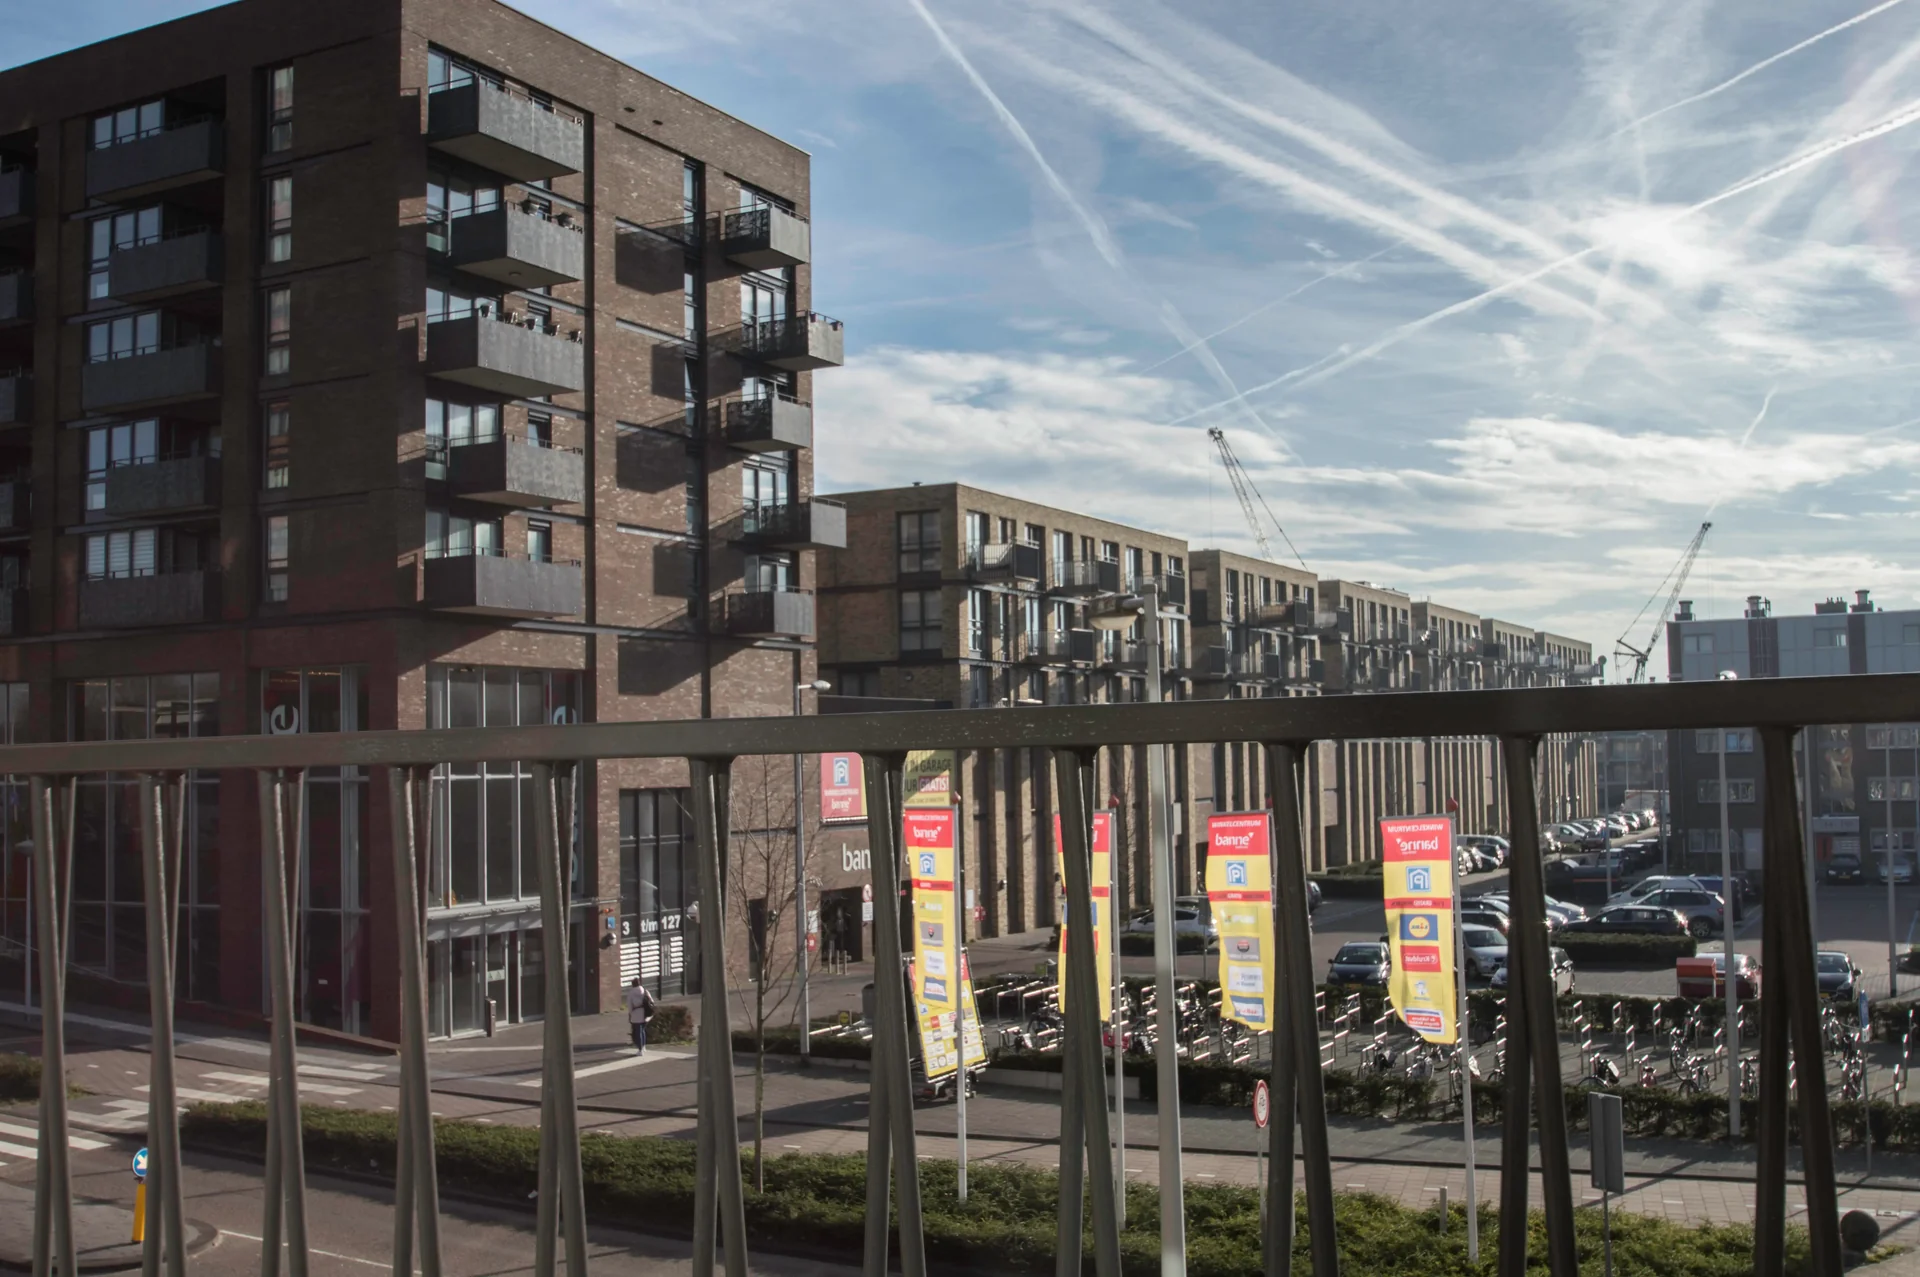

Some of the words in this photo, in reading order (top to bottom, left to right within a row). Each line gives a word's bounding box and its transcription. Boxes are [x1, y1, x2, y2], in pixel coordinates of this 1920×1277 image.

[920, 758, 952, 772] GARAGE
[919, 777, 950, 792] GRATIS!
[1212, 820, 1262, 828] WINKELCENTRUM
[1215, 833, 1250, 846] banne
[622, 921, 630, 936] 3
[640, 918, 658, 932] t/m
[662, 914, 681, 930] 127
